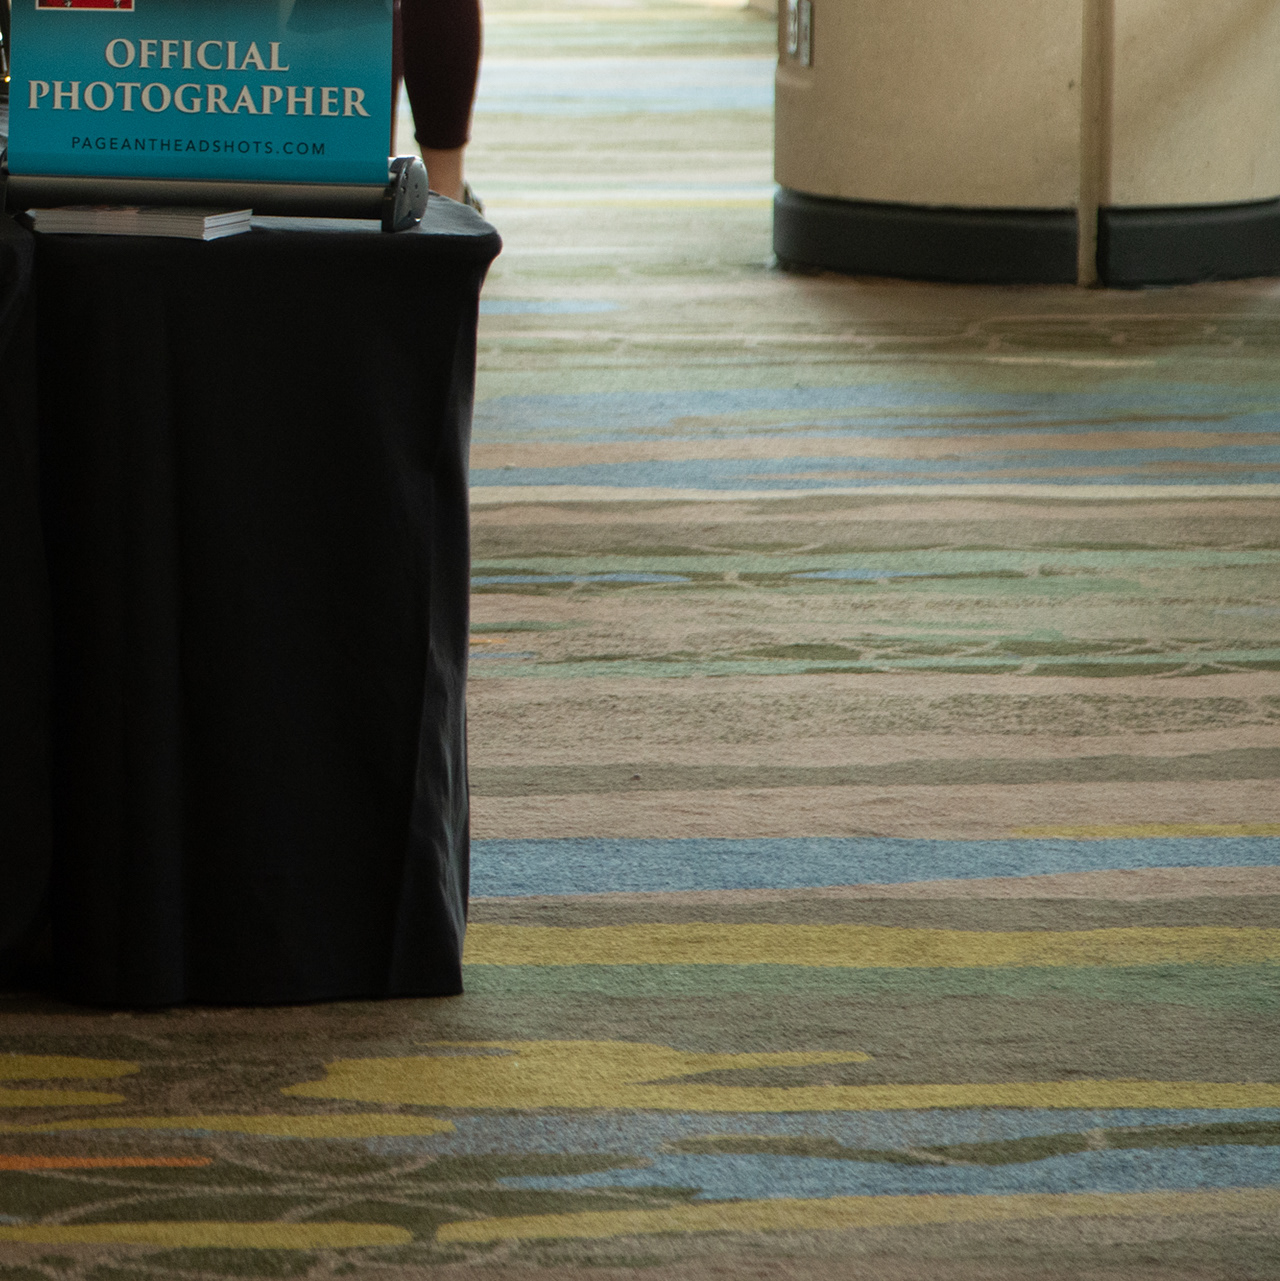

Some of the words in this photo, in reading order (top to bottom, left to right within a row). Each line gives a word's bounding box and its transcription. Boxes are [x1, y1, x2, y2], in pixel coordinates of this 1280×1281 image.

[104, 38, 290, 72] OFFICIAL
[27, 80, 372, 118] PHOTOGRAPHER
[71, 135, 326, 156] PAGEANTHEADSHOTS.COM
